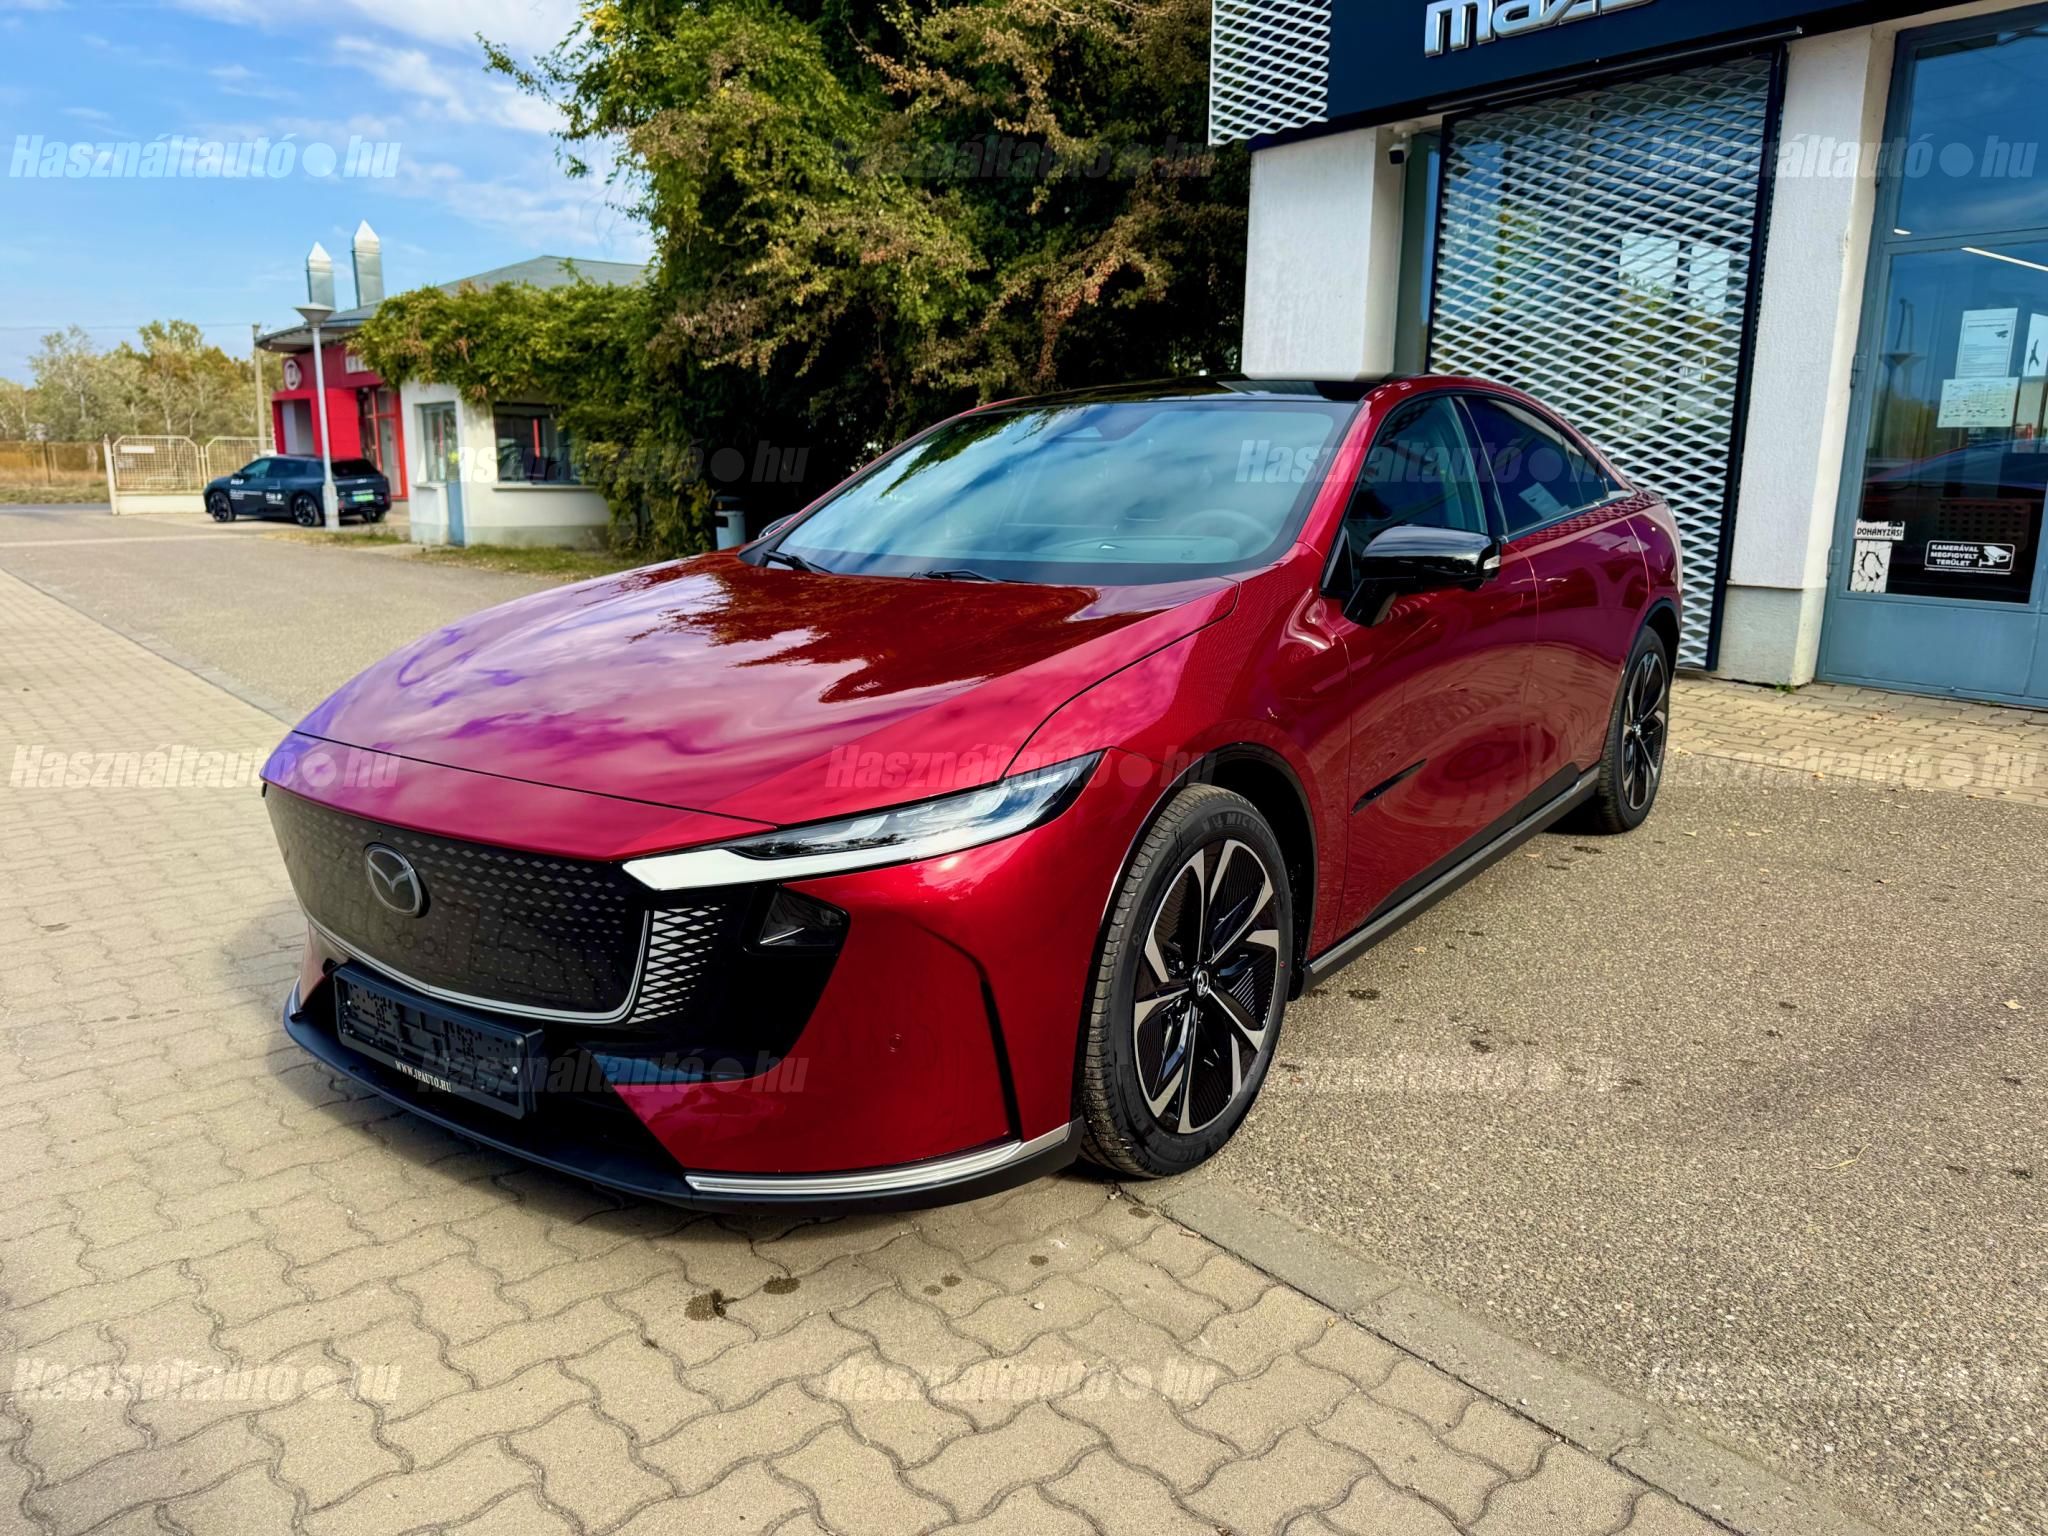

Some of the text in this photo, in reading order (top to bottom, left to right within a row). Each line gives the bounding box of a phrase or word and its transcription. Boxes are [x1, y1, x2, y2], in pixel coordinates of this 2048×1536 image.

[1931, 543, 1979, 553] KAMERÁVAL
[1930, 551, 1979, 560] MEGFIGYELT
[1936, 558, 1971, 567] TERÜLET
